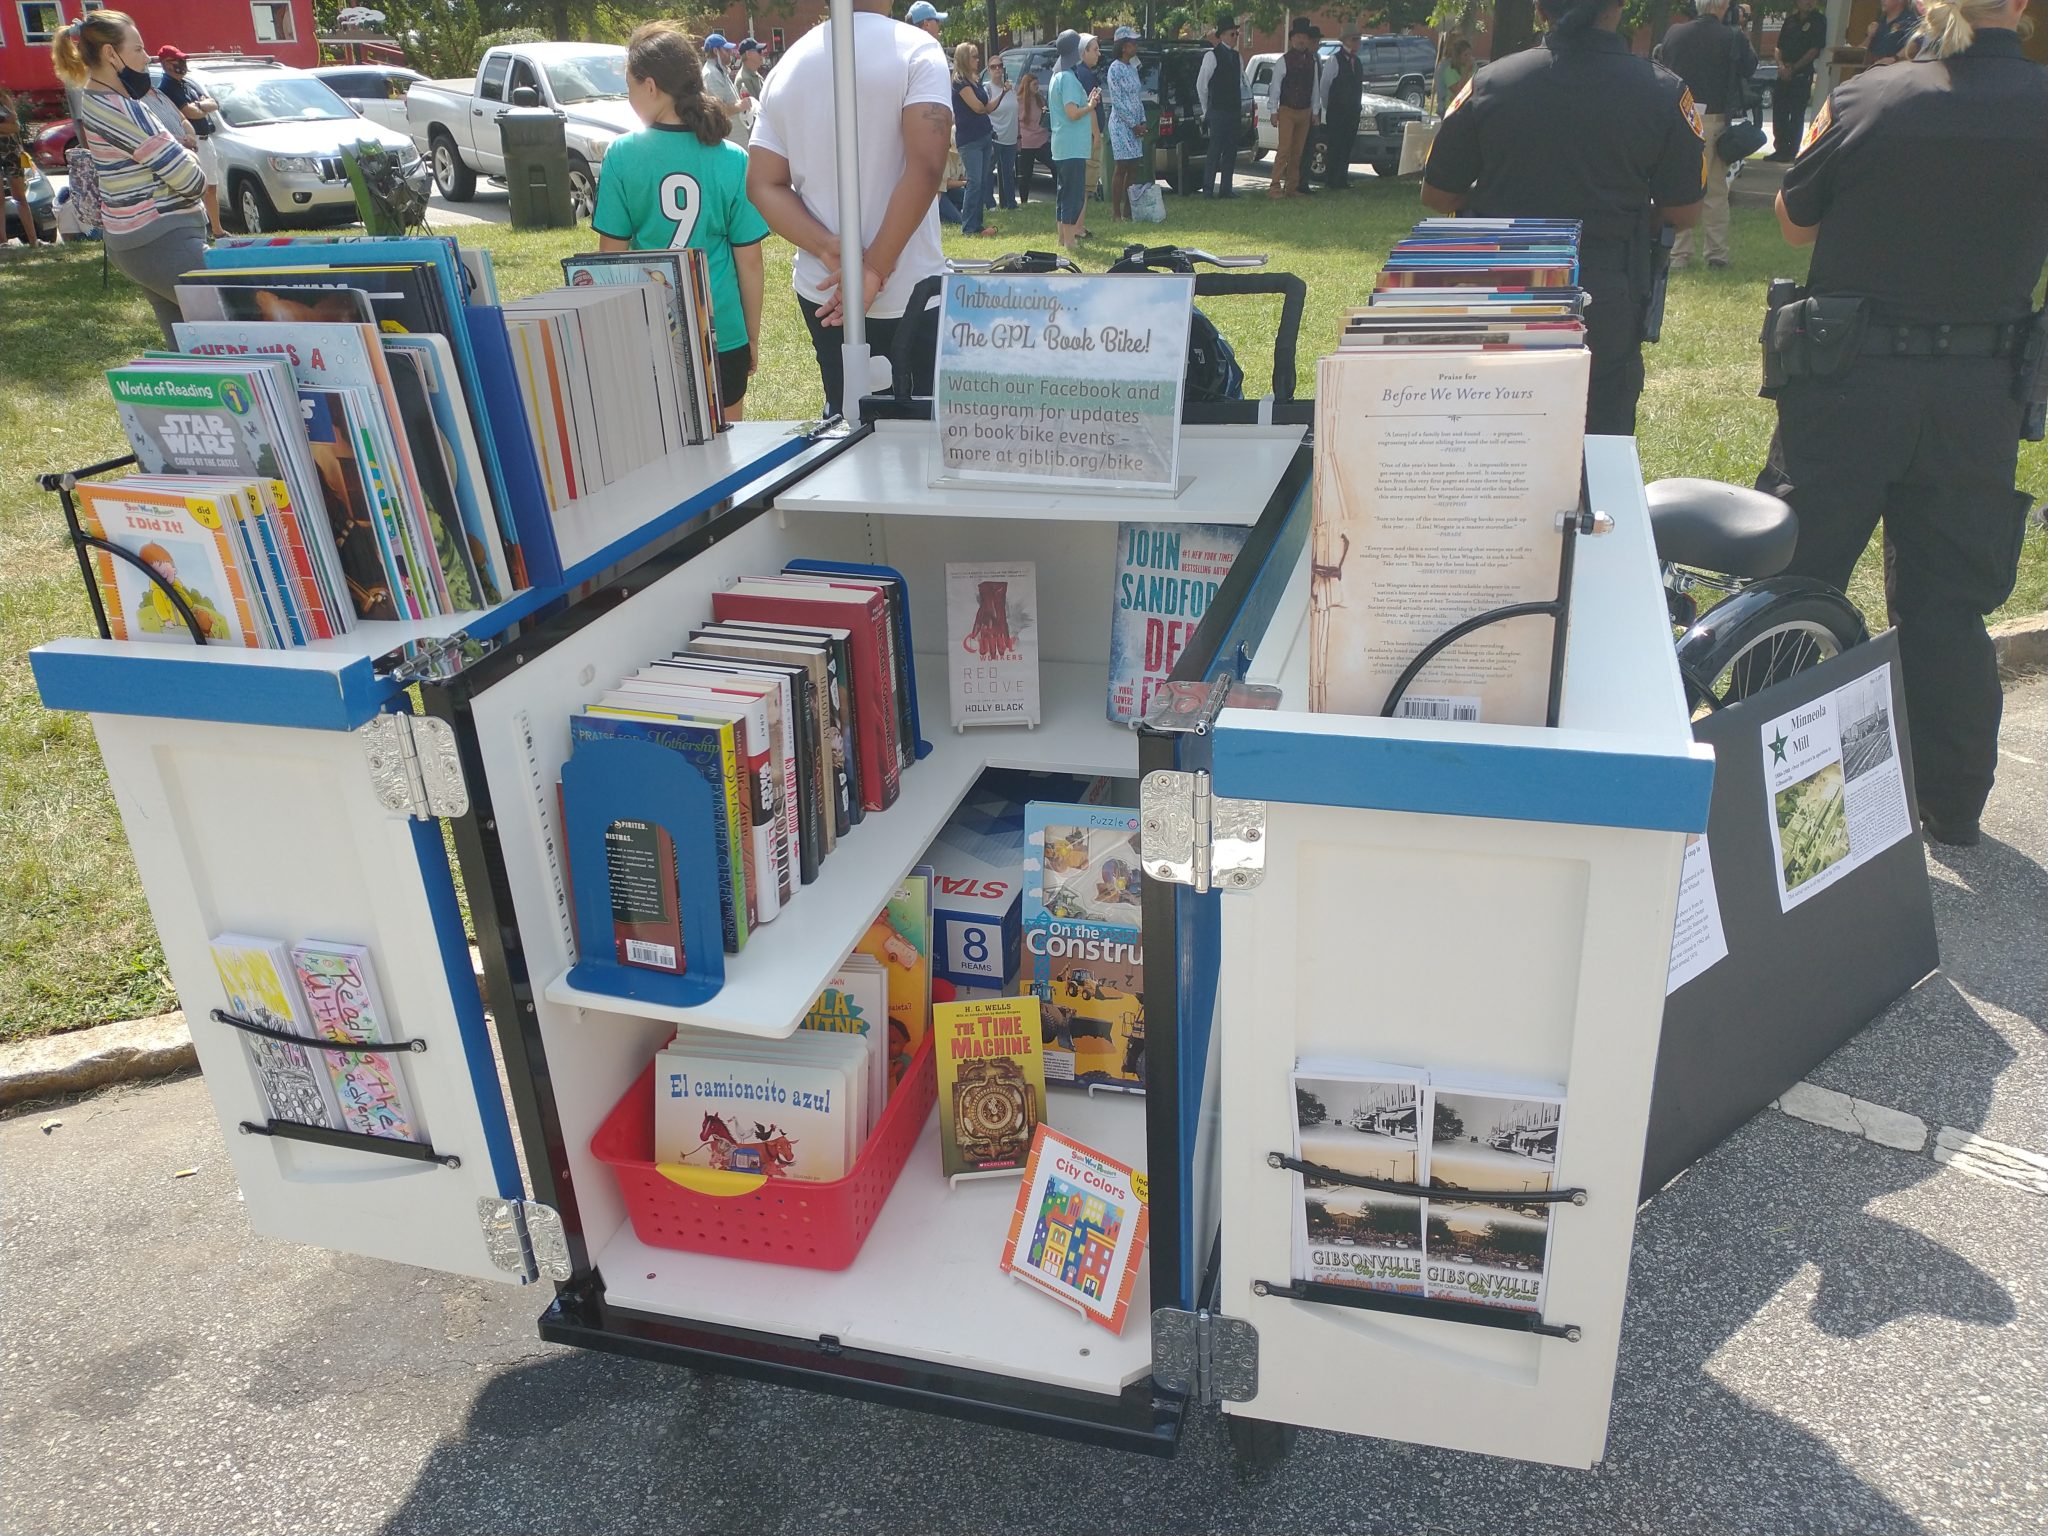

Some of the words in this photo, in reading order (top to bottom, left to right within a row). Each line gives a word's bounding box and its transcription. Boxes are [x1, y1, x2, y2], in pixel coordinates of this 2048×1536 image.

[659, 172, 702, 249] 9
[955, 284, 1079, 323] Introducing...
[952, 322, 987, 348] The
[991, 323, 1036, 349] GPL
[1043, 324, 1095, 351] Book
[1100, 326, 1151, 353] Bike!
[311, 348, 326, 371] A
[1438, 373, 1463, 381] Praise
[1465, 373, 1477, 381] for
[116, 380, 152, 397] World
[154, 380, 166, 396] of
[167, 381, 213, 399] Reading
[948, 376, 999, 394] Watch
[1005, 380, 1034, 394] our
[1040, 379, 1120, 399] Facebook
[1127, 384, 1160, 401] and
[1382, 385, 1427, 408] Before
[1430, 389, 1452, 400] We
[1456, 388, 1492, 401] Were
[1494, 387, 1534, 400] Yours
[229, 390, 243, 412] 1
[948, 400, 1034, 420] Instagram
[1040, 402, 1065, 422] for
[1070, 406, 1139, 424] updates
[158, 414, 233, 435] STAR
[948, 425, 968, 438] on
[974, 423, 1014, 440] book
[1020, 424, 1054, 442] bike
[1059, 430, 1115, 446] events
[160, 434, 235, 456] WARS
[949, 447, 991, 461] more
[996, 448, 1013, 463] at
[1018, 448, 1143, 472] giblib.org/bike
[196, 506, 211, 515] did
[203, 515, 210, 524] it
[126, 516, 136, 528] I
[136, 517, 161, 531] Did
[163, 520, 184, 534] It!
[1126, 528, 1182, 571] JOHN
[1192, 550, 1203, 560] NEW
[1204, 551, 1218, 561] YORK
[1218, 552, 1233, 562] TIMES
[1181, 564, 1212, 575] BESTSELLING
[1213, 566, 1231, 576] AUTHO
[980, 654, 1023, 662] WORKERS
[964, 667, 998, 679] RED
[964, 681, 1024, 694] GLOVE
[803, 680, 812, 721] CARTER
[819, 675, 831, 741] UNLOVELY
[965, 704, 992, 713] HOLLY
[995, 703, 1024, 712] BLACK
[1113, 695, 1134, 705] FLOWERS
[1117, 705, 1132, 715] NOVEL
[1791, 704, 1826, 732] Minneola
[647, 730, 721, 764] Mothership
[1793, 734, 1810, 754] Mill
[786, 769, 797, 792] RED
[710, 783, 731, 853] EXTREMELY
[1090, 815, 1124, 827] Puzzle
[768, 826, 778, 872] LEIA
[933, 876, 1009, 899] STA
[1050, 922, 1071, 936] On
[1075, 924, 1100, 940] the
[963, 927, 989, 962] 8
[1026, 928, 1144, 965] Constru
[961, 961, 992, 972] REAMS
[985, 1003, 1011, 1011] WELLS
[954, 1022, 976, 1036] THE
[978, 1016, 1023, 1037] TIME
[951, 1036, 1032, 1060] MACHINE
[670, 1074, 689, 1098] El
[695, 1074, 786, 1104] camioncito
[792, 1089, 830, 1113] azul
[1056, 1158, 1081, 1180] City
[1083, 1171, 1125, 1200] Colors
[1136, 1175, 1148, 1187] loo
[1136, 1186, 1148, 1196] for
[1311, 1250, 1421, 1273] GIBSONVILLE
[1354, 1263, 1376, 1279] City
[1377, 1267, 1389, 1279] of
[1427, 1265, 1540, 1295] GIBSONVILLE
[1469, 1281, 1490, 1298] City
[1491, 1286, 1503, 1299] of
